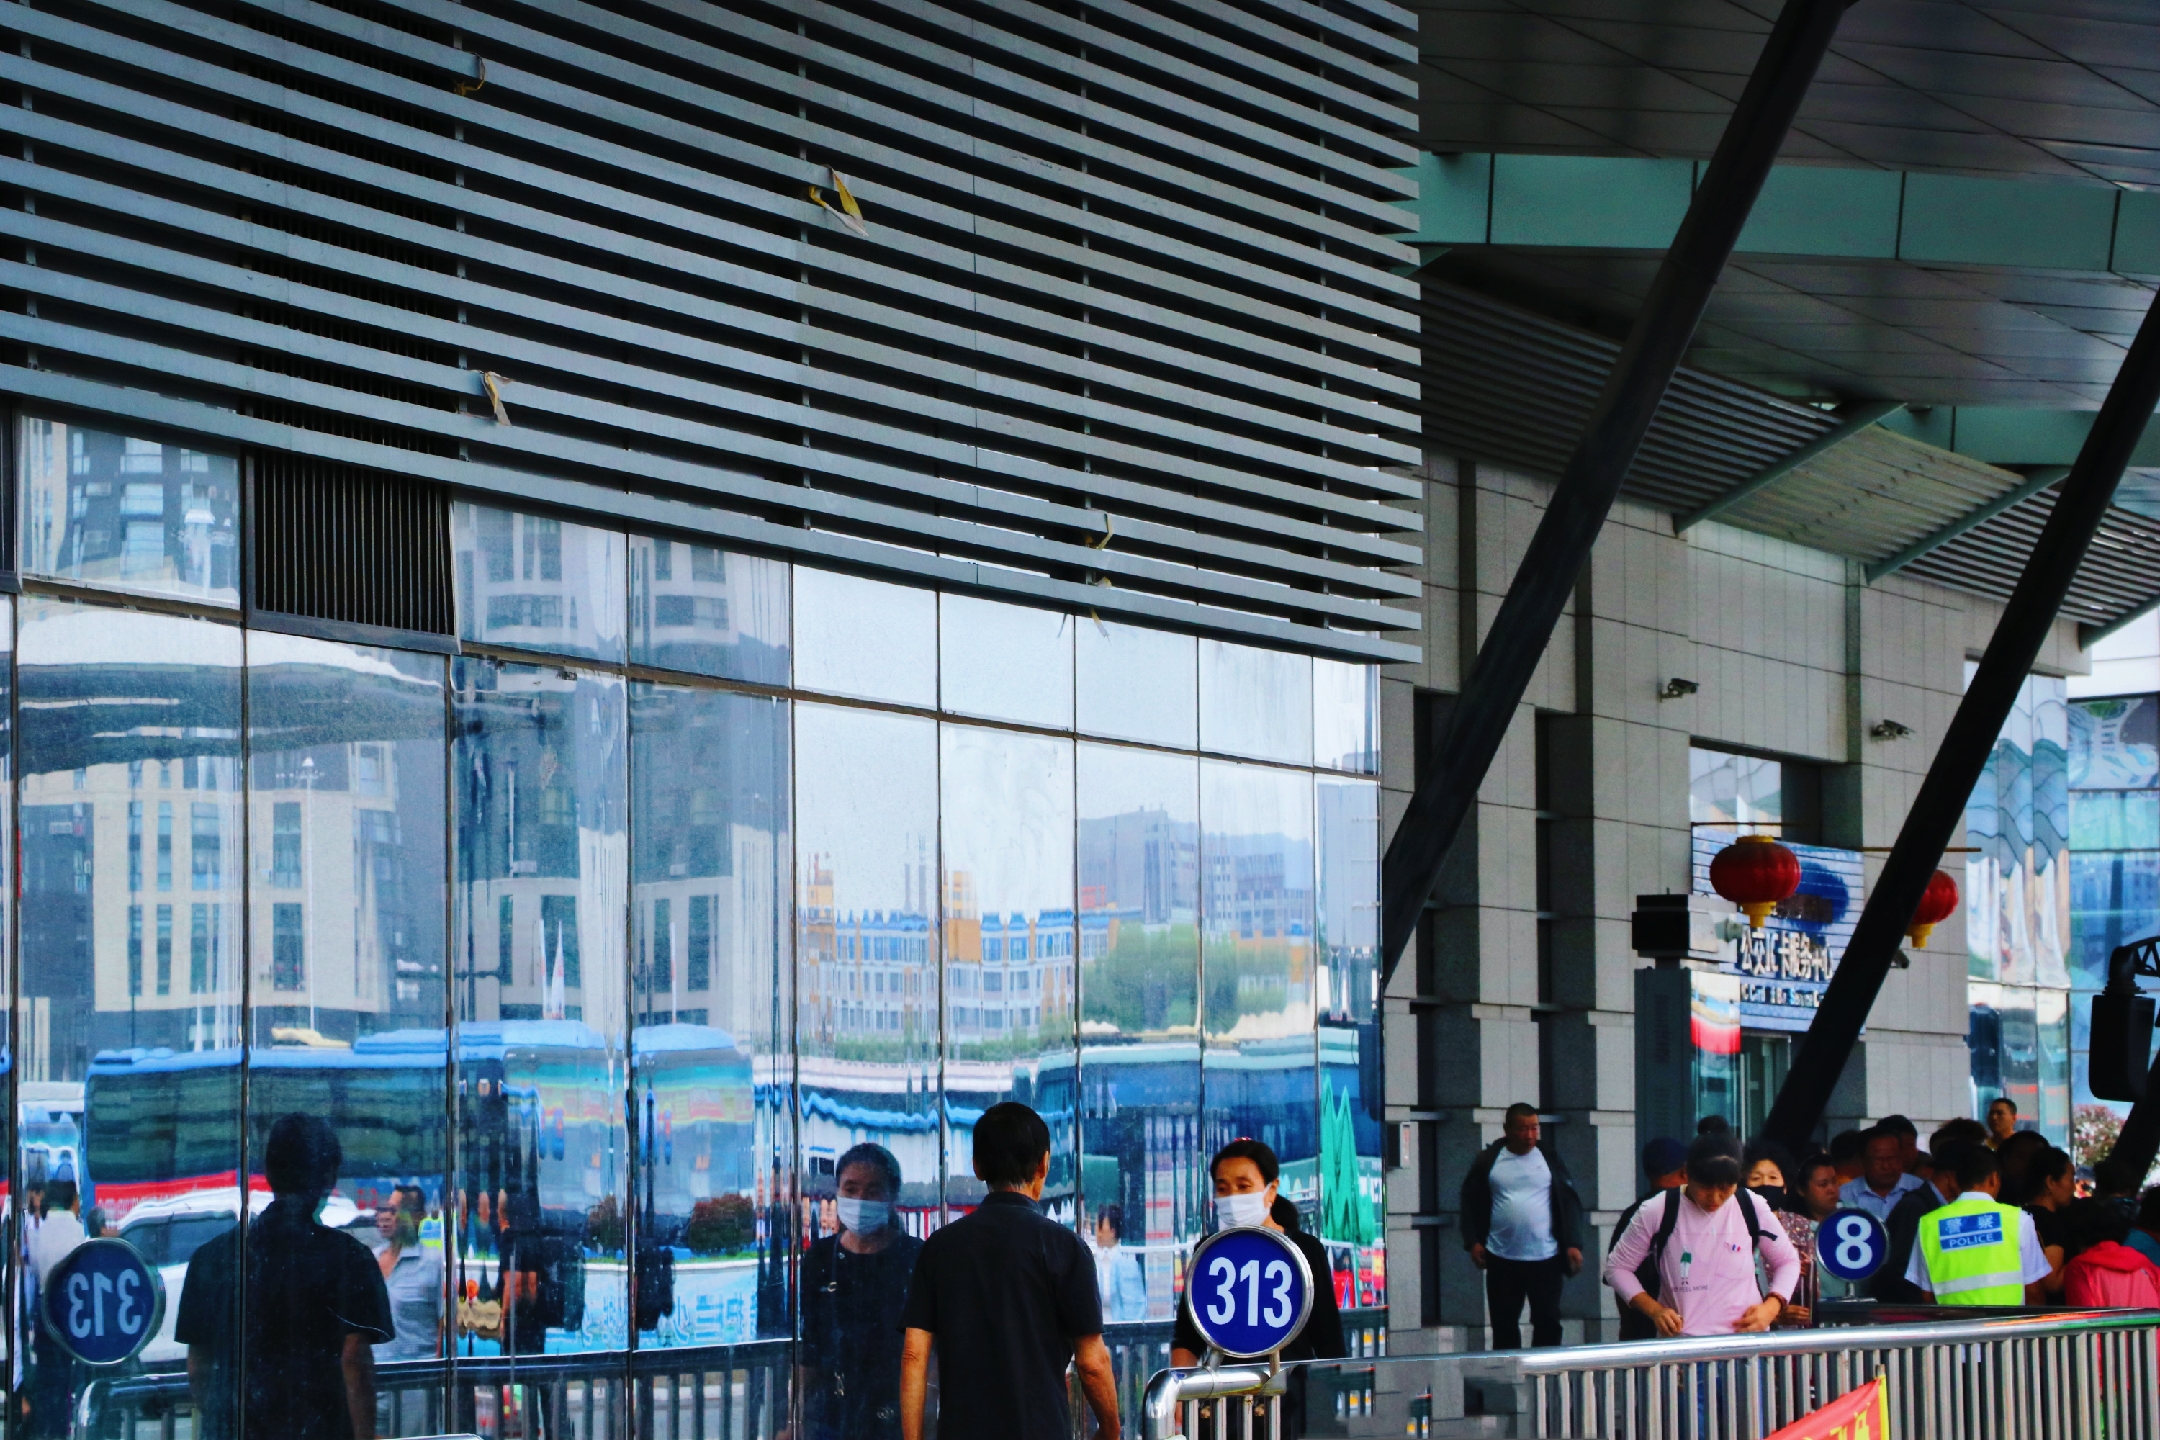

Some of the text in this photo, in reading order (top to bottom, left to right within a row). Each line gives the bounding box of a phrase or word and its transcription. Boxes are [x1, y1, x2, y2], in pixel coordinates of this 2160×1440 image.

[1740, 927, 1833, 981] 公交IC卡服务中心
[1835, 1215, 1872, 1269] 8
[1945, 1215, 1993, 1234] 警察
[1949, 1233, 1994, 1248] POLICE
[1206, 1256, 1293, 1328] 313
